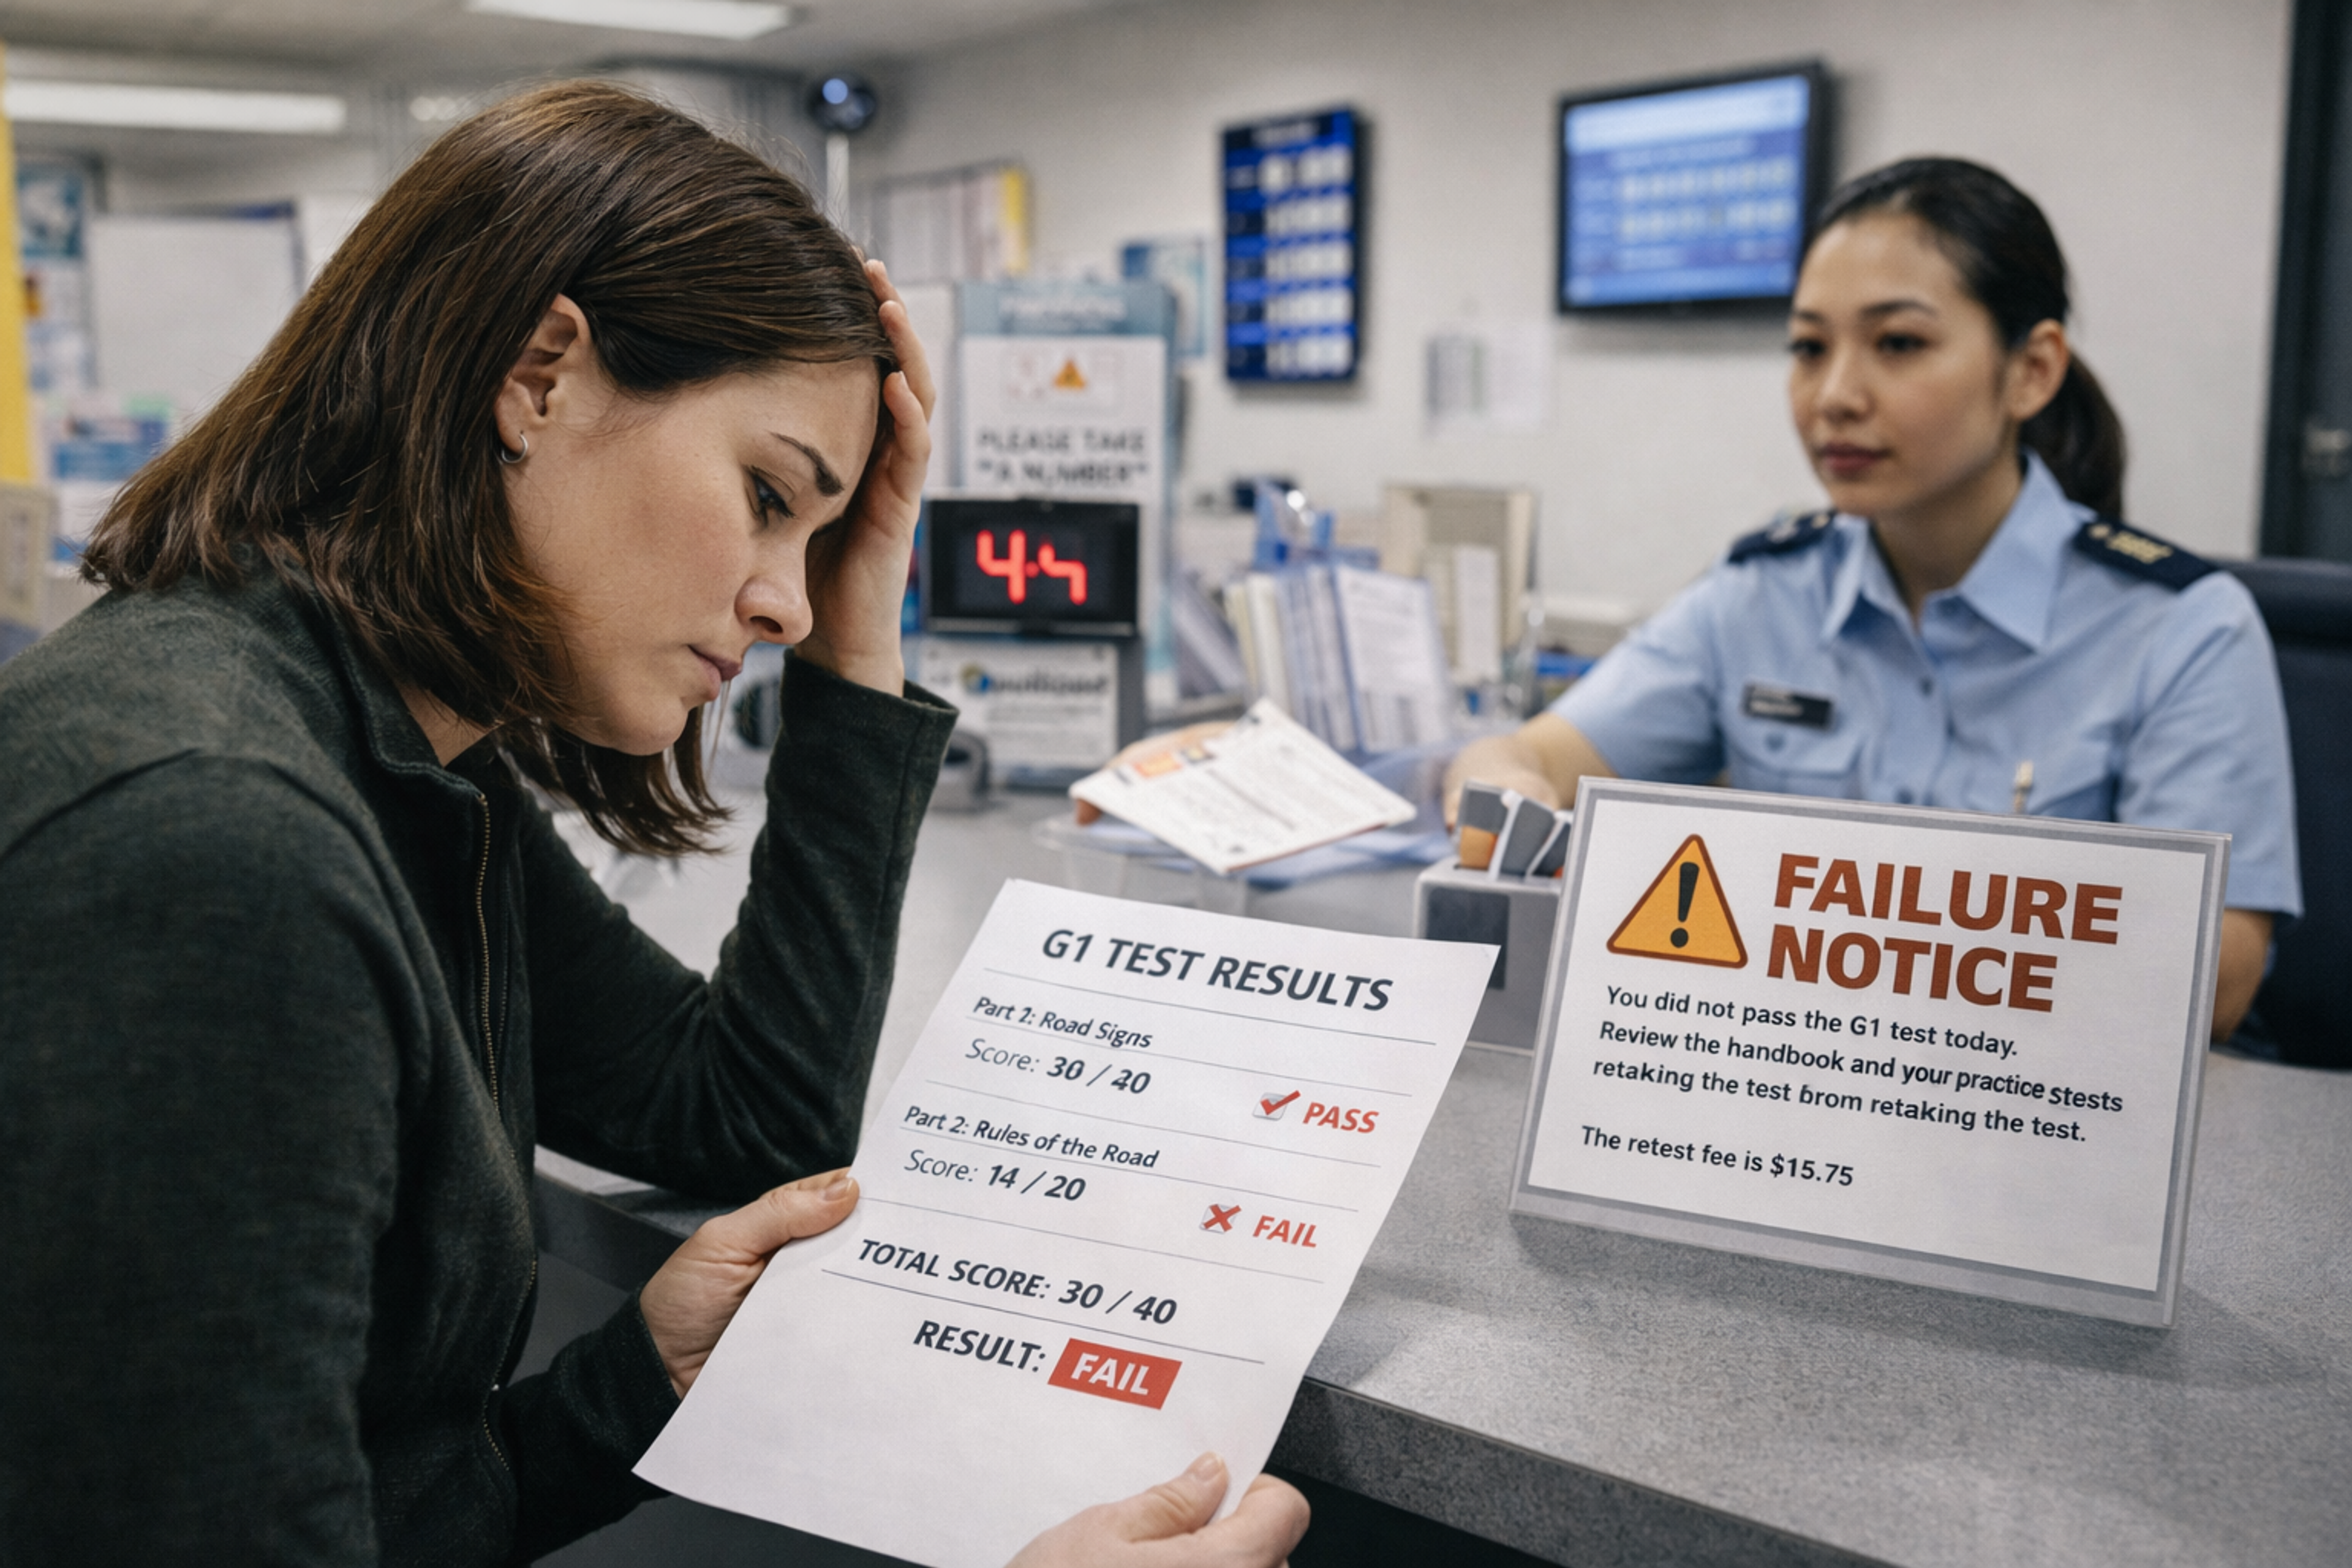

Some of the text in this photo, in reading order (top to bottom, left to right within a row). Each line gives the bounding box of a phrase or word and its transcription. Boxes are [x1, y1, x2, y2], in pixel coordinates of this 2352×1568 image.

[1774, 853, 2124, 945] FAILURE
[1042, 929, 1393, 1011] G1 TEST RESULTS
[1766, 923, 2059, 1013] NOTICE
[973, 996, 1016, 1020] Part
[1039, 1011, 1094, 1036] Road
[1095, 1022, 1153, 1049] Signs
[1607, 986, 2018, 1060] You did not pass the G1 test today.
[965, 1038, 1040, 1073] Score:
[1086, 1064, 1112, 1087] /
[1600, 1020, 2123, 1112] Review the handbook and your practice stests
[903, 1106, 1160, 1168] Part 2: Rules of the Road
[1303, 1102, 1379, 1134] PASS
[1593, 1061, 1695, 1093] retaking
[1702, 1071, 1739, 1095] the
[1746, 1079, 1792, 1102] test
[1870, 1098, 1977, 1131] retaking
[1984, 1109, 2024, 1133] the
[2031, 1117, 2086, 1142] test.
[903, 1149, 1087, 1201] Score: 14 / 20
[1581, 1125, 1853, 1186] The retest fee is $15.75
[1253, 1215, 1316, 1248] FAIL
[859, 1238, 1177, 1324] TOTAL SCORE: 30 / 40
[913, 1320, 1150, 1396] RESULT: FAIL
